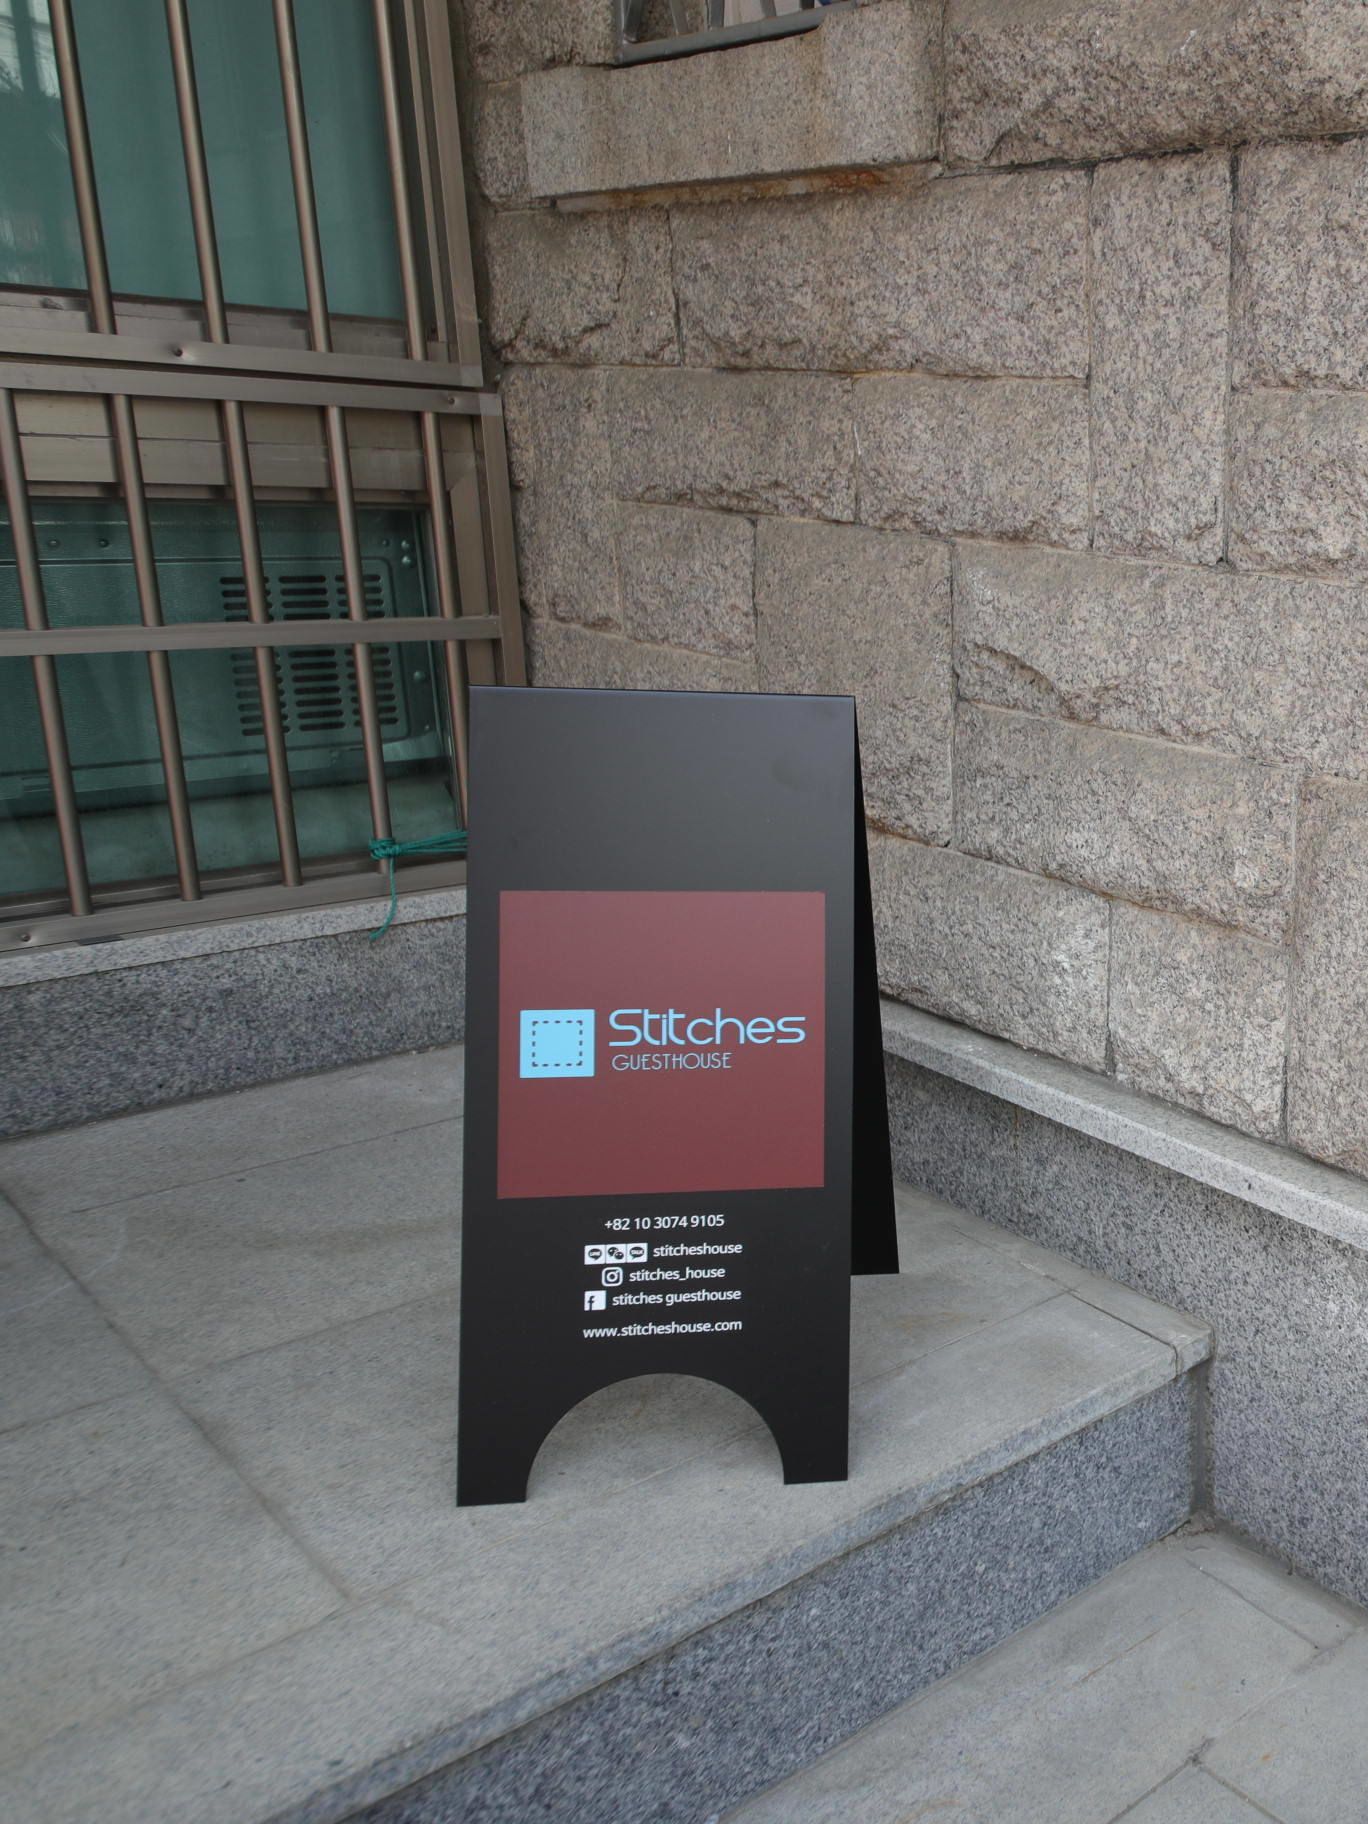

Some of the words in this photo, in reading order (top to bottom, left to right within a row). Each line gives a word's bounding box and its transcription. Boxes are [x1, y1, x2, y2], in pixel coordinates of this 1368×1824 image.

[608, 1007, 807, 1047] Stitches
[611, 1052, 732, 1072] GUESTHOUSE
[605, 1218, 631, 1231] +82
[635, 1217, 651, 1230] 10
[653, 1216, 688, 1229] 3074
[690, 1214, 725, 1227] 9105
[653, 1242, 743, 1257] stitcheshouse
[629, 1267, 726, 1282] stitches_house
[612, 1291, 664, 1306] stitches
[665, 1288, 742, 1306] guesthouse
[583, 1320, 743, 1338] www.stitcheshouse.com
